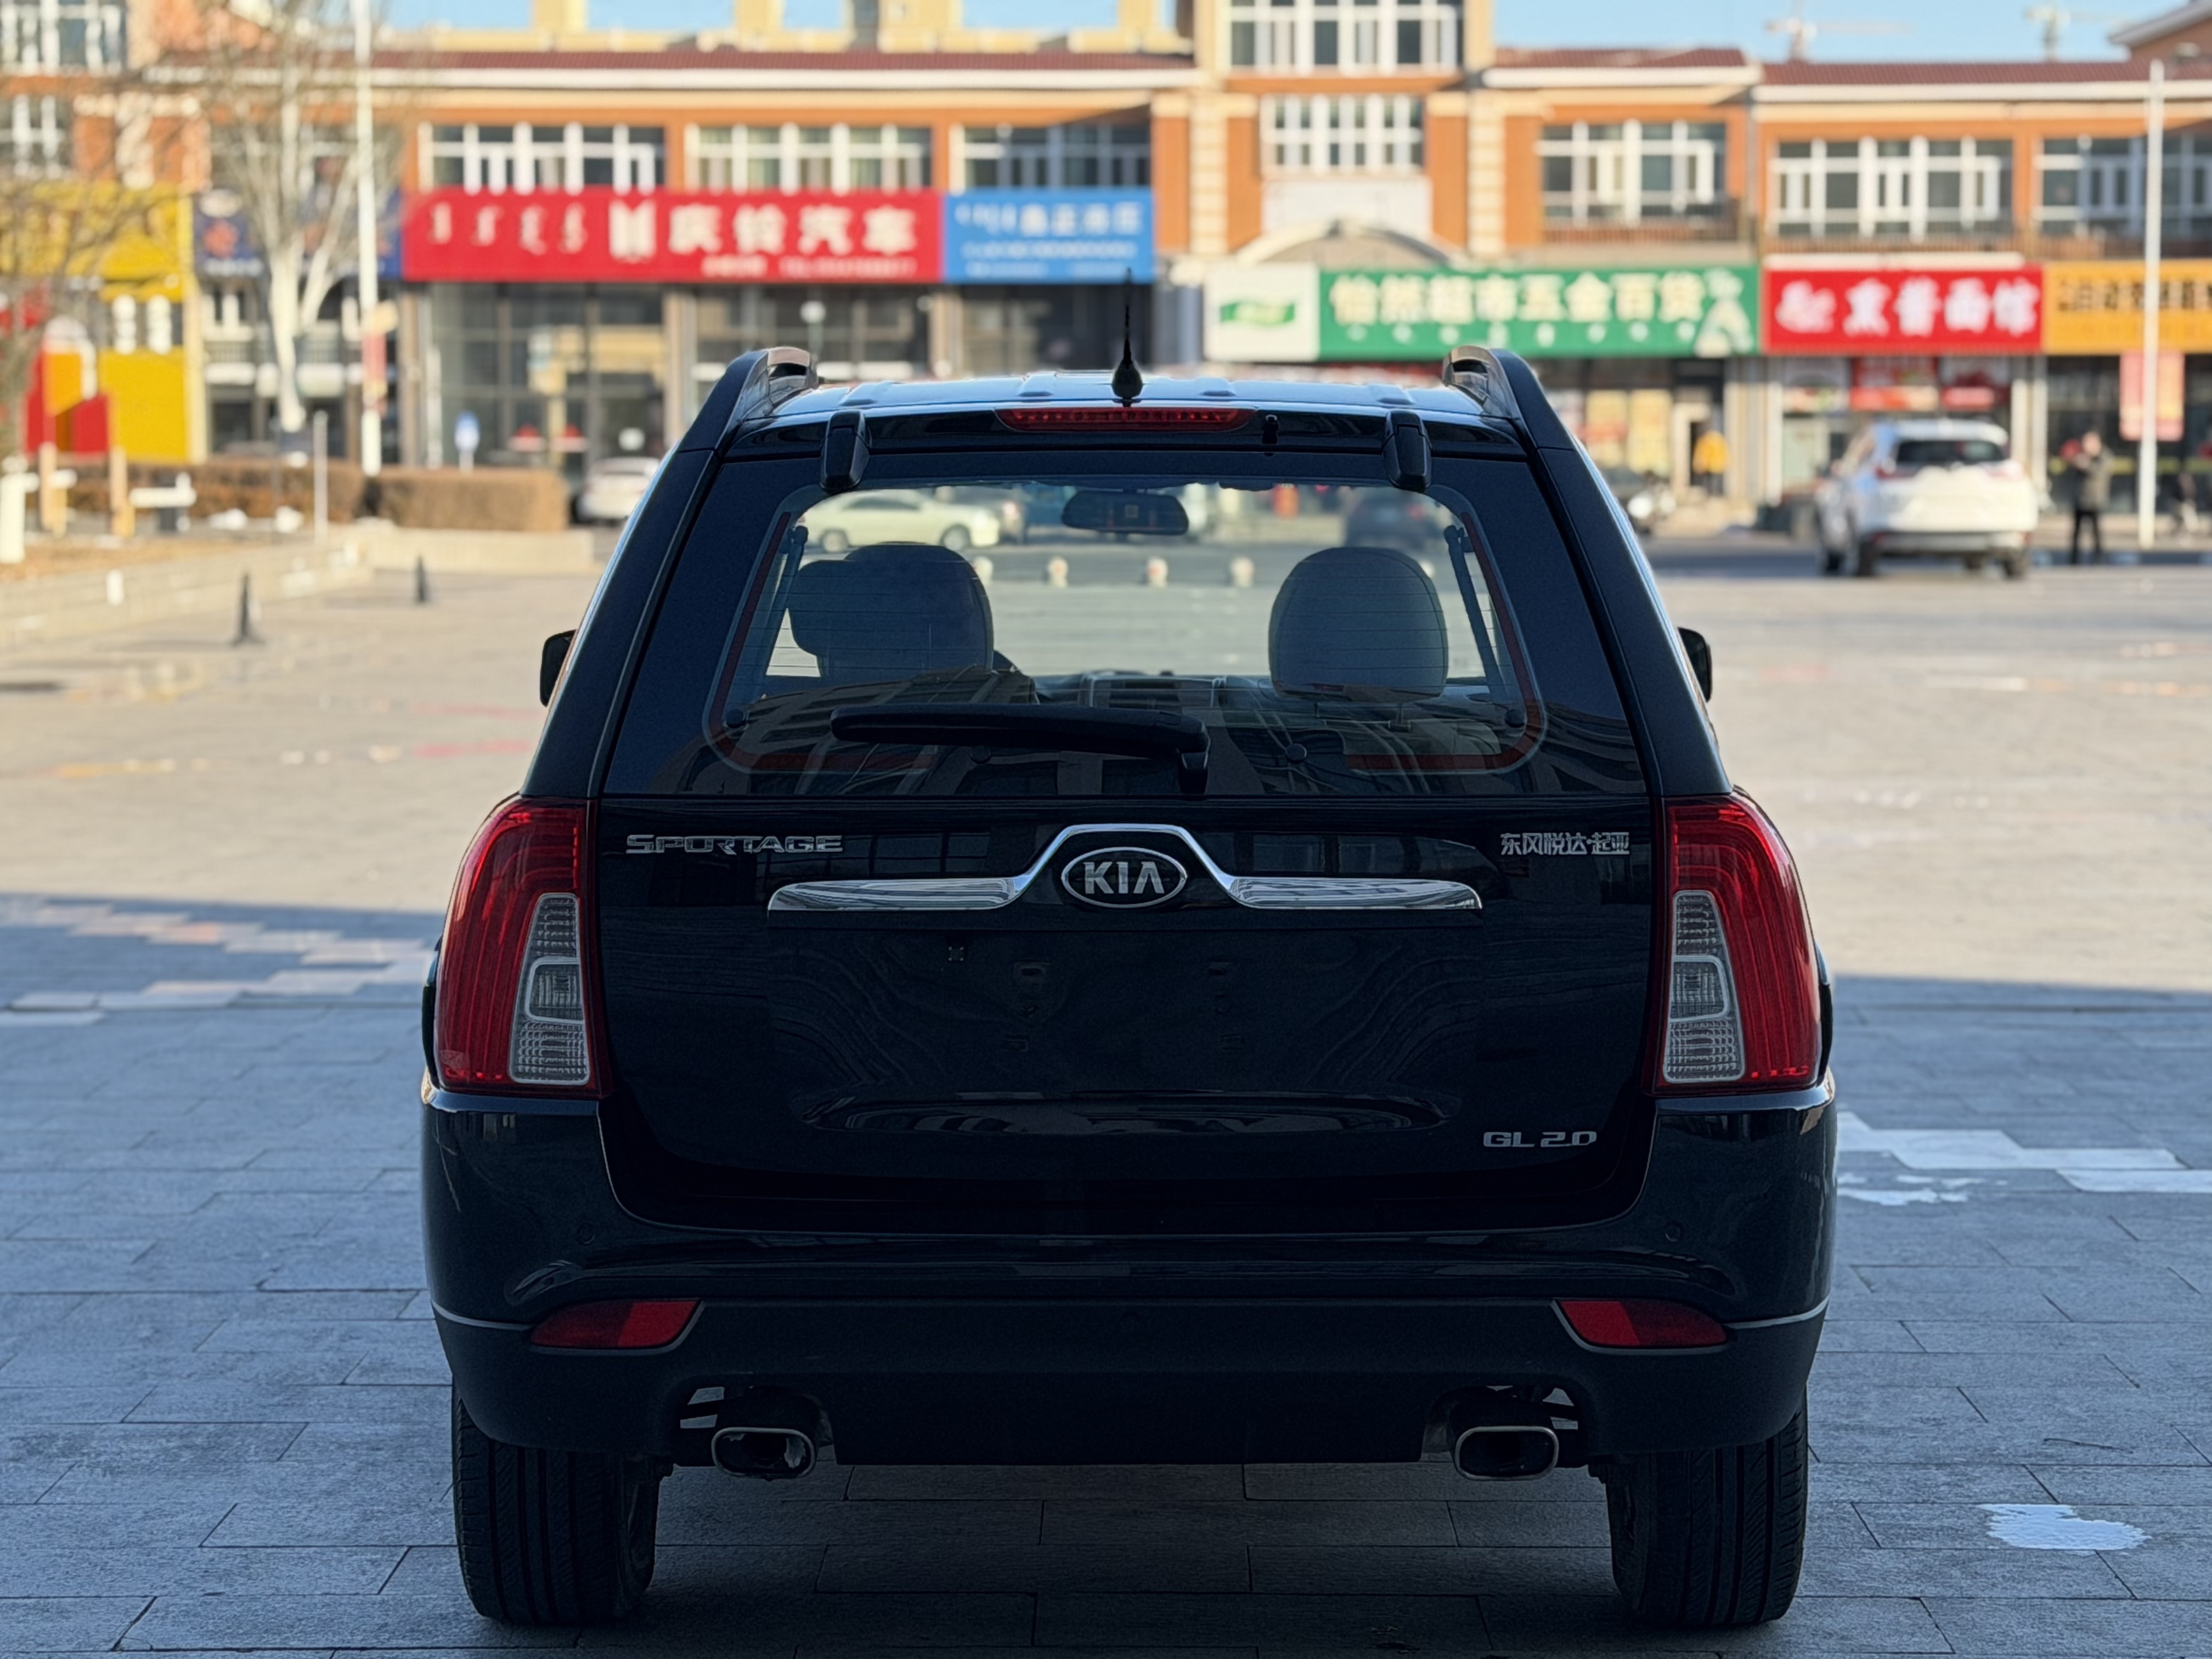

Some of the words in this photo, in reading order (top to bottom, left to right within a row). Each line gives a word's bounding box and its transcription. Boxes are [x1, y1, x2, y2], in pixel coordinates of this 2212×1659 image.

[625, 834, 843, 855] SPORTAGE
[1082, 861, 1165, 895] KIA
[1483, 1131, 1535, 1148] GL
